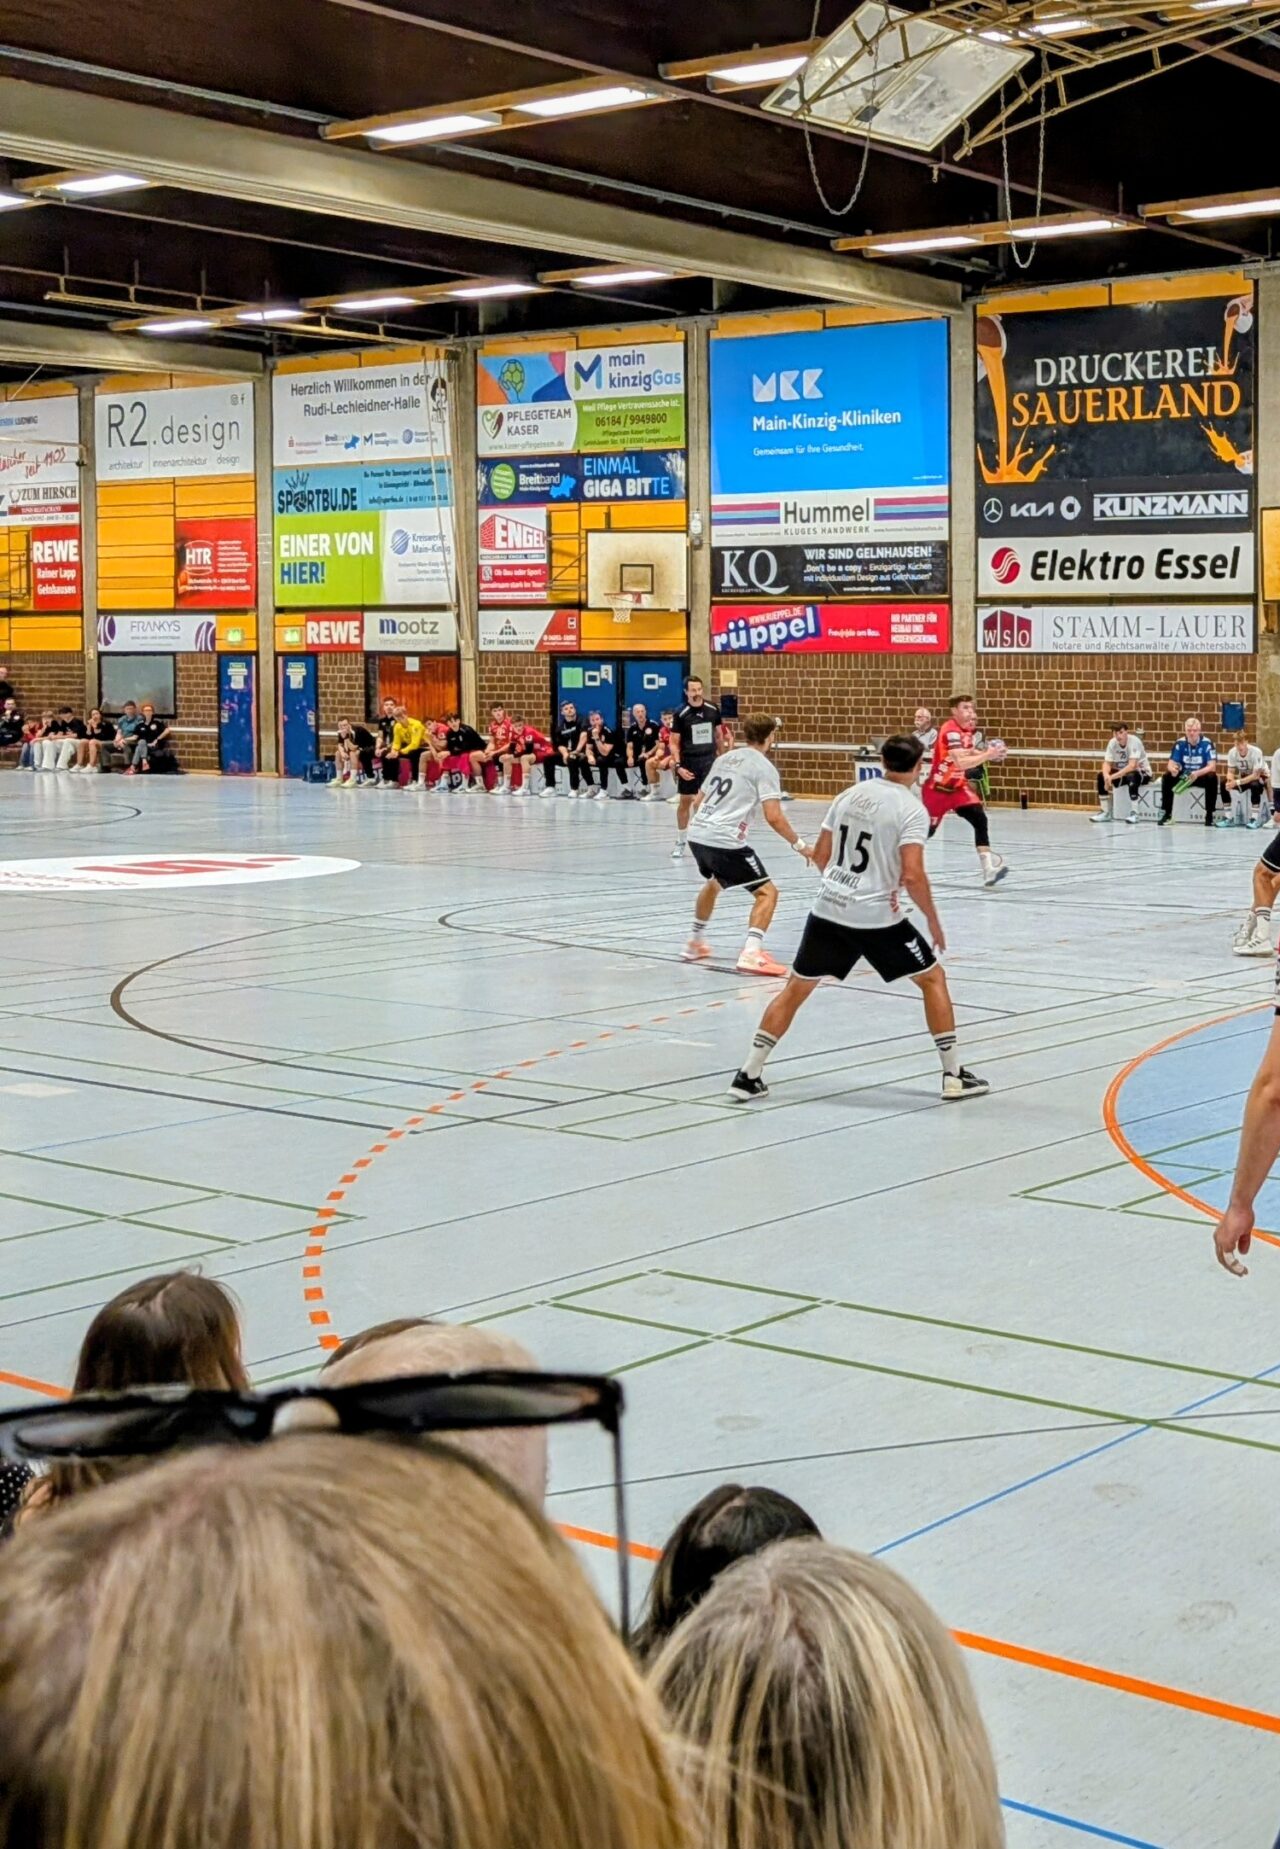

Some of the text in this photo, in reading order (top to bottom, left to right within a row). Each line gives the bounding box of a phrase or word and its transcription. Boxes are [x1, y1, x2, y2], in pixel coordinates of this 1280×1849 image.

[609, 350, 645, 368] main
[1034, 346, 1217, 387] DRUCKEREI
[291, 372, 430, 397] Herzlich Willkommen in der
[609, 369, 681, 391] kinzigGas
[303, 395, 420, 417] Rudi-Lechleidner-Halle
[507, 408, 571, 421] PFLEGETEAM
[1012, 380, 1241, 427] SAUERLAND
[108, 401, 240, 450] R2.design
[507, 424, 539, 436] KASER
[595, 415, 622, 427] 06184
[629, 412, 667, 425] 9949800
[753, 408, 901, 432] Main-Kinzig-Kliniken
[217, 454, 240, 466] design
[584, 455, 640, 476] EINMAL
[519, 472, 560, 485] Breitband
[584, 476, 670, 498] GIGA BITTE
[21, 485, 77, 502] ZUM HIRSCH
[784, 497, 870, 524] Hummel
[1094, 493, 1249, 518] KUNZMANN
[496, 514, 545, 549] ENGEL
[784, 526, 818, 536] KLUGES
[821, 525, 870, 535] HANDWERK
[33, 539, 79, 564] REWE
[280, 532, 331, 558] EINER
[334, 531, 374, 556] VON
[804, 546, 932, 560] WIR SIND GELNHAUSEN!
[185, 547, 212, 565] HTR
[1030, 546, 1241, 581] Elektro Essel
[59, 567, 76, 581] Lapp
[280, 561, 325, 584] HIER!
[721, 549, 790, 595] KQ
[845, 564, 862, 575] copy
[131, 620, 181, 632] FRANKYS
[379, 618, 439, 635] mootz
[713, 605, 815, 652] rüppel
[901, 613, 925, 623] PARTNER
[307, 620, 360, 645] REWE
[1053, 641, 1246, 650] Notare und Rechtsanwälte Wächtersbach
[837, 823, 872, 874] 15
